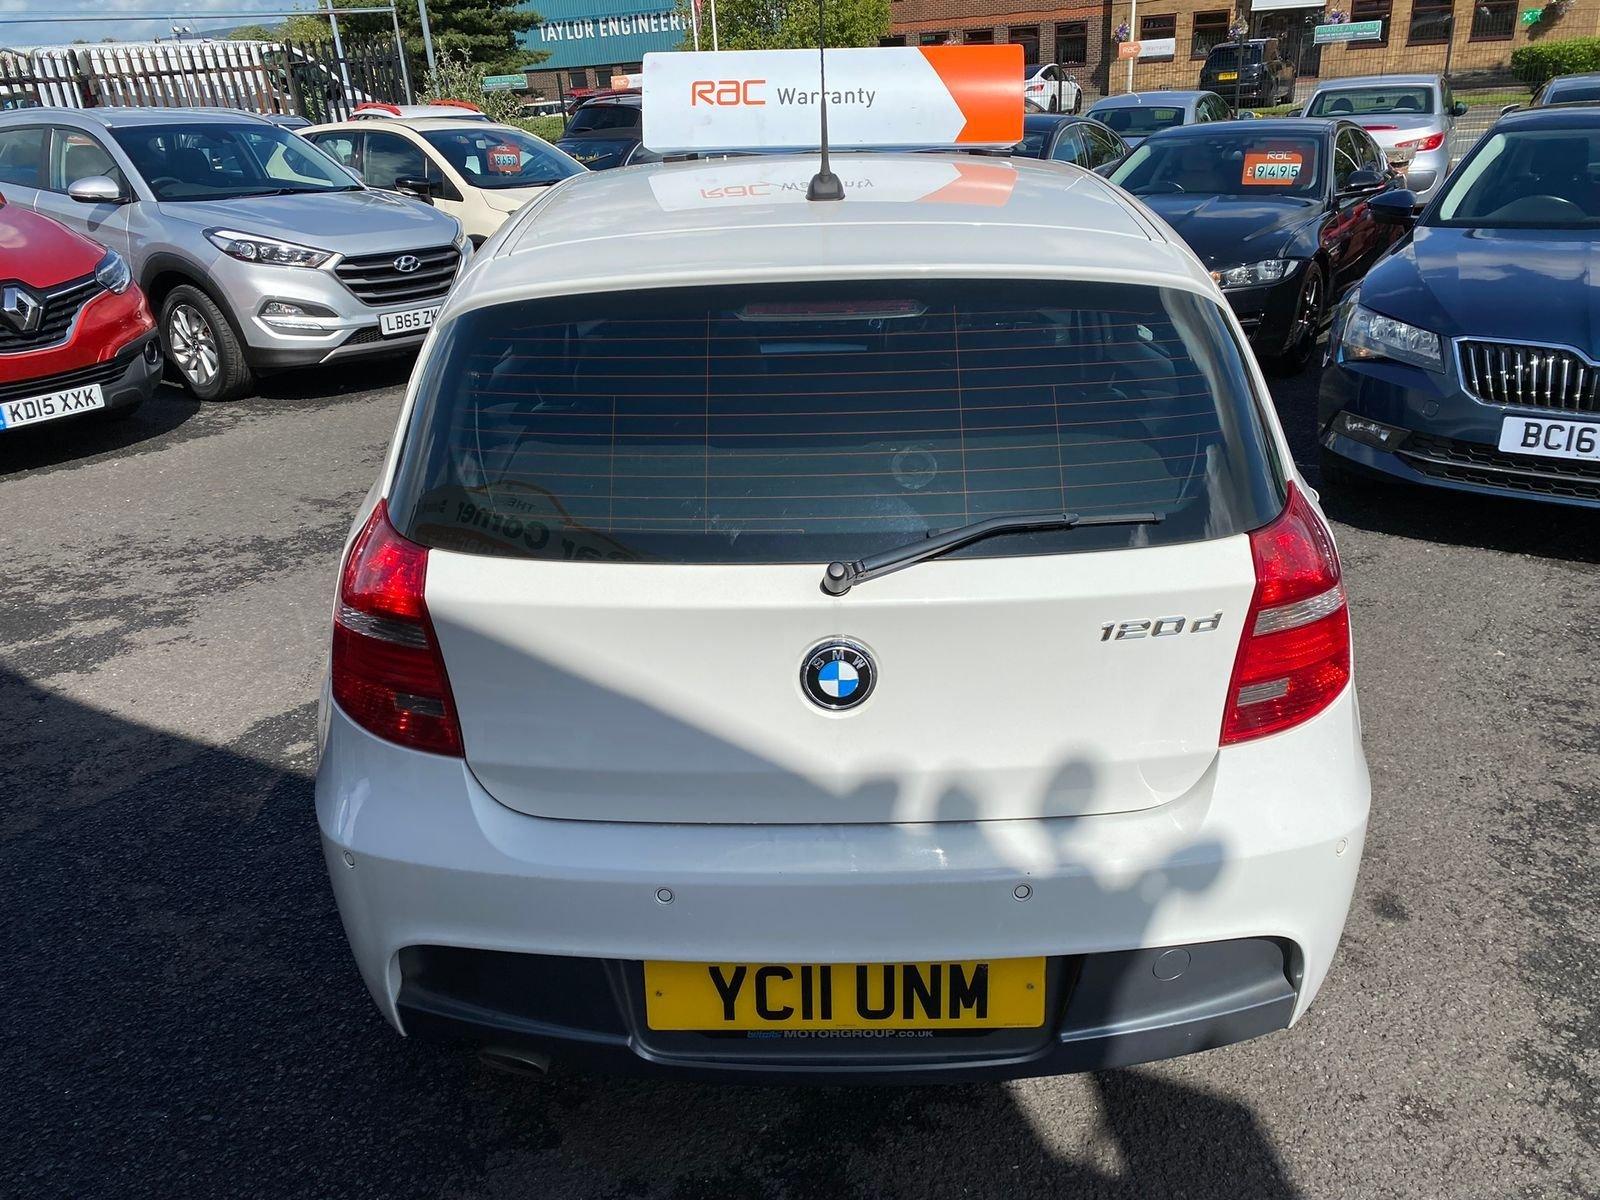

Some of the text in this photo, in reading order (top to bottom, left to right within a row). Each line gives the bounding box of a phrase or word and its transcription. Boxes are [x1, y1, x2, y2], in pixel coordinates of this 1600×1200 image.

[540, 19, 595, 42] TAYLOR
[777, 87, 876, 108] Warranty
[385, 312, 420, 331] LB65
[9, 388, 97, 422] KD15 XXK
[1520, 422, 1598, 453] BC16
[811, 649, 867, 671] BMW
[708, 963, 989, 1021] YC11 UNM
